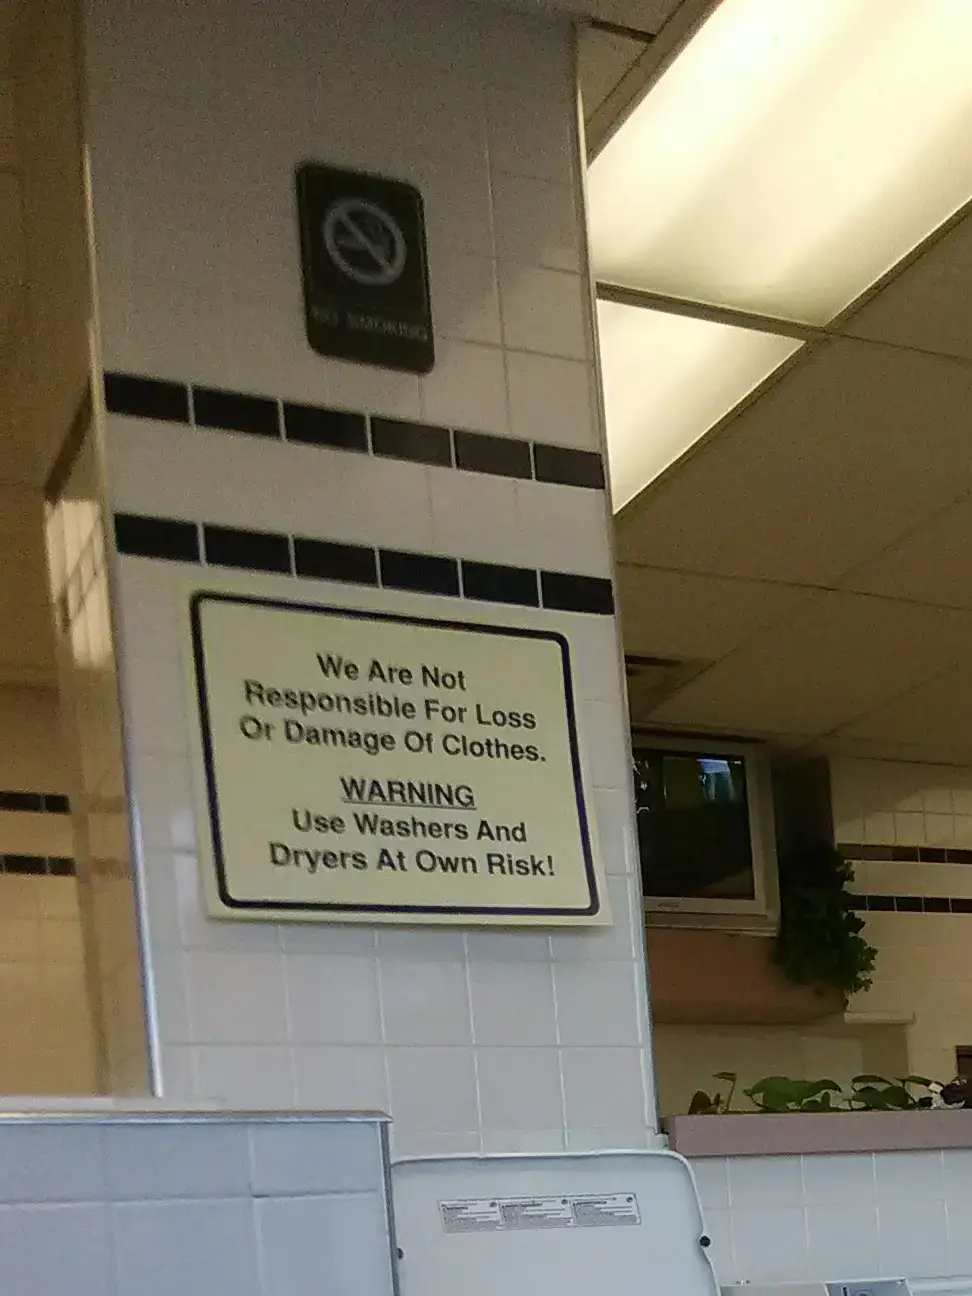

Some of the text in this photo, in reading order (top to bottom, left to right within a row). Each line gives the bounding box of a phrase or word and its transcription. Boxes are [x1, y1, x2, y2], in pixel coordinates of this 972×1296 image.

[316, 652, 467, 692] We Are Not
[244, 679, 537, 730] Responsible For Loss
[239, 714, 547, 762] Or Damage Of Clothes.
[339, 776, 476, 808] WARNING
[292, 808, 527, 843] Use Washers And
[268, 841, 555, 876] Dryers At Own Risk!
